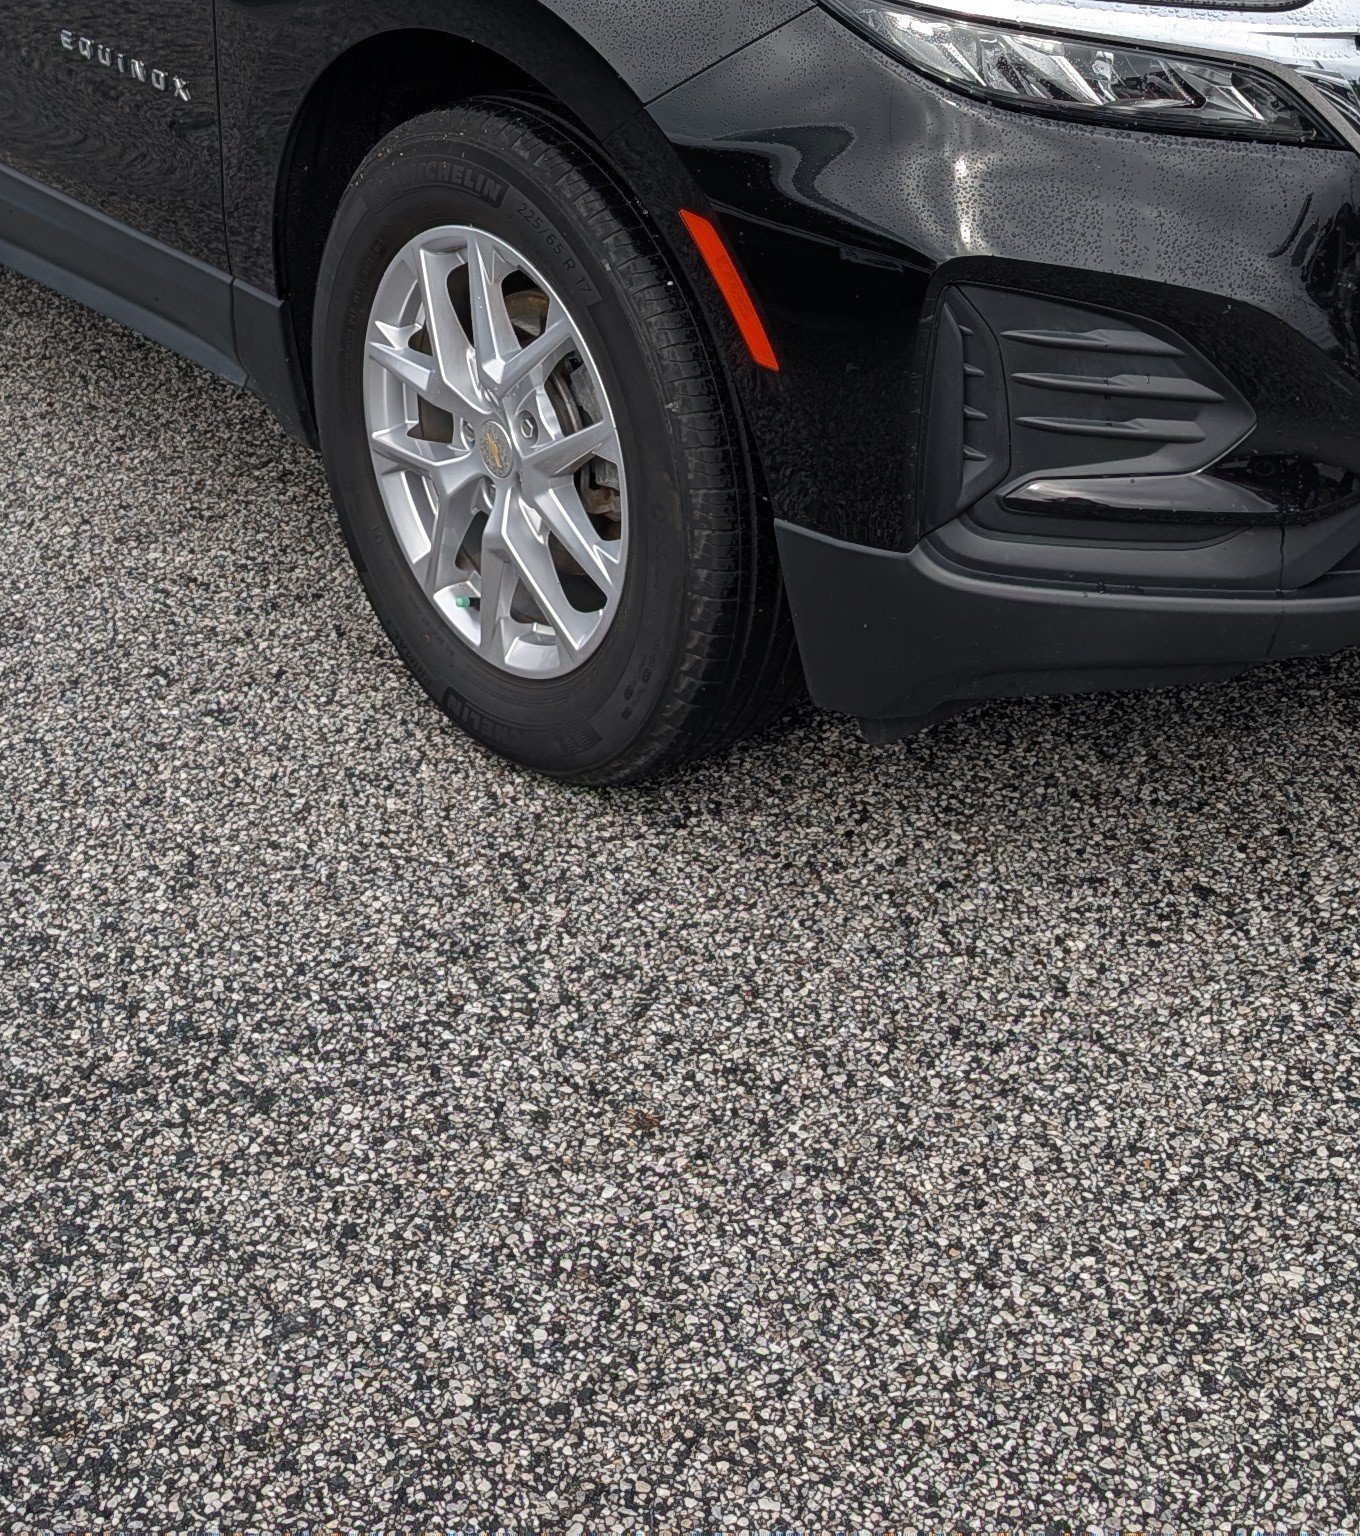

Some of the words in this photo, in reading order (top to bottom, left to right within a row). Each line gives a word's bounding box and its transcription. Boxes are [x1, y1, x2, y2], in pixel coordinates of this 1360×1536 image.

[60, 29, 191, 102] EQUINOX
[517, 203, 564, 255] 225/65
[563, 258, 576, 271] R
[577, 275, 593, 292] 17
